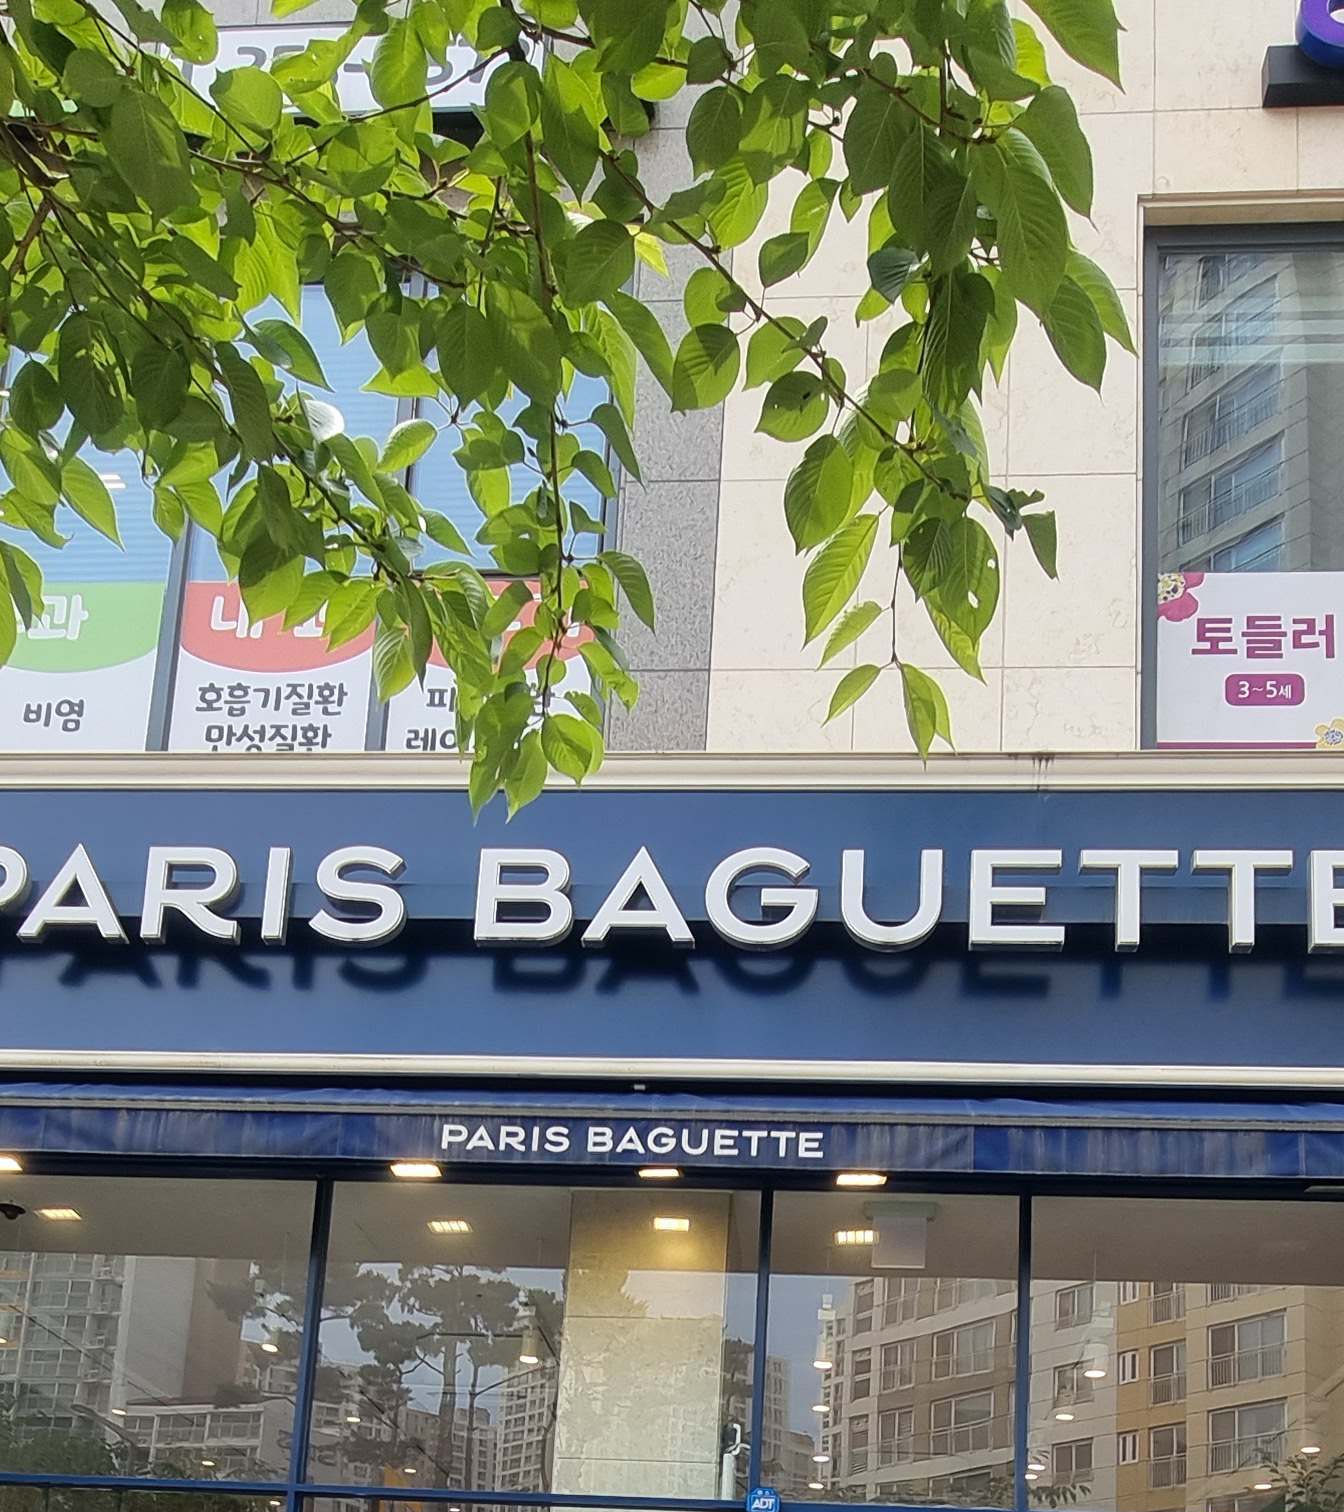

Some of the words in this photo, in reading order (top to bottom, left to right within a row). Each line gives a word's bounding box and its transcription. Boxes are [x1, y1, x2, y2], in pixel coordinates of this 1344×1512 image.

[1192, 614, 1337, 660] 토들러
[196, 682, 348, 716] 호흡기질환
[1237, 680, 1293, 700] 3~5세
[23, 699, 85, 732] 비염
[441, 1124, 570, 1152] PARIS
[587, 1127, 824, 1158] BAGUETTE
[751, 1497, 775, 1510] ADT
